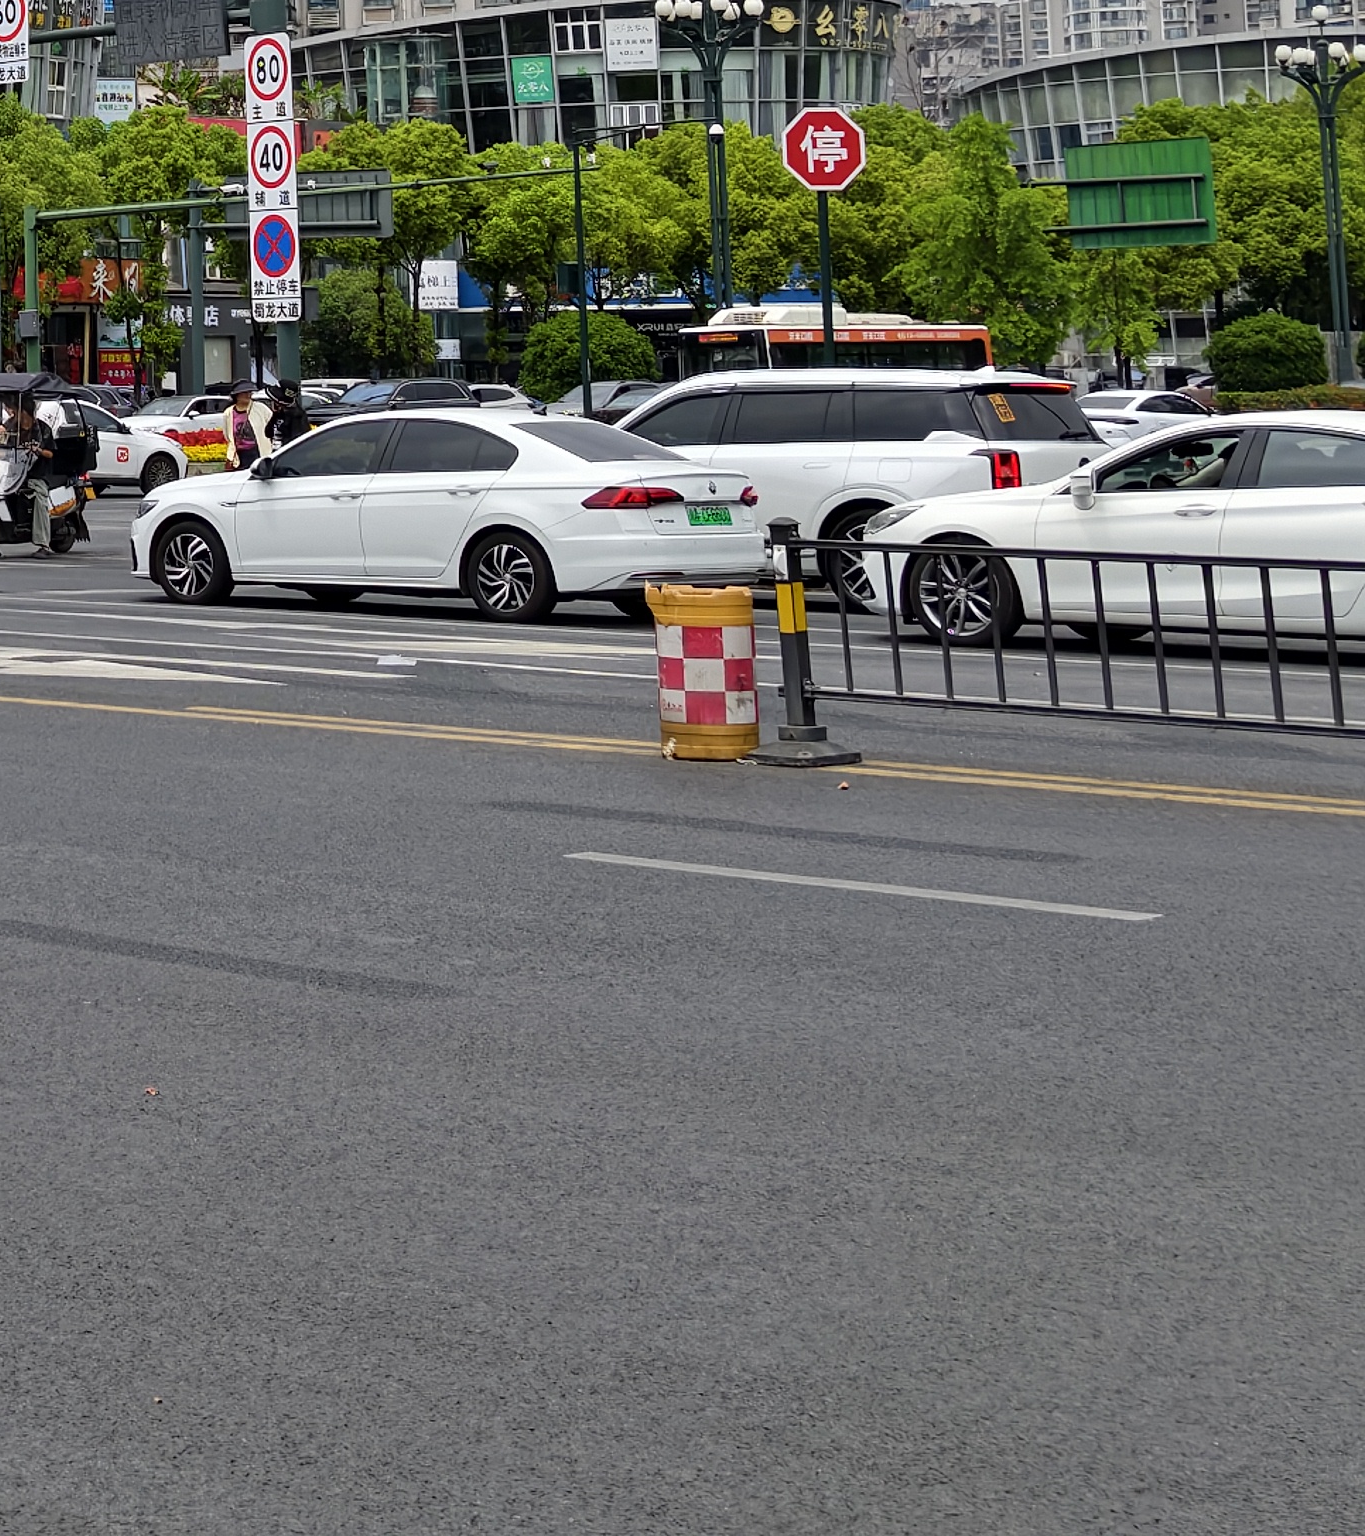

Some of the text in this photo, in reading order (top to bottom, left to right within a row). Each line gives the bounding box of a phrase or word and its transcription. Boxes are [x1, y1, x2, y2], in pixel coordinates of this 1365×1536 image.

[256, 55, 280, 84] 80
[252, 101, 287, 120] 主道
[260, 142, 284, 172] 40
[800, 126, 848, 173] 停
[253, 279, 300, 296] 禁止停车
[254, 302, 300, 319] 蜀龙大道
